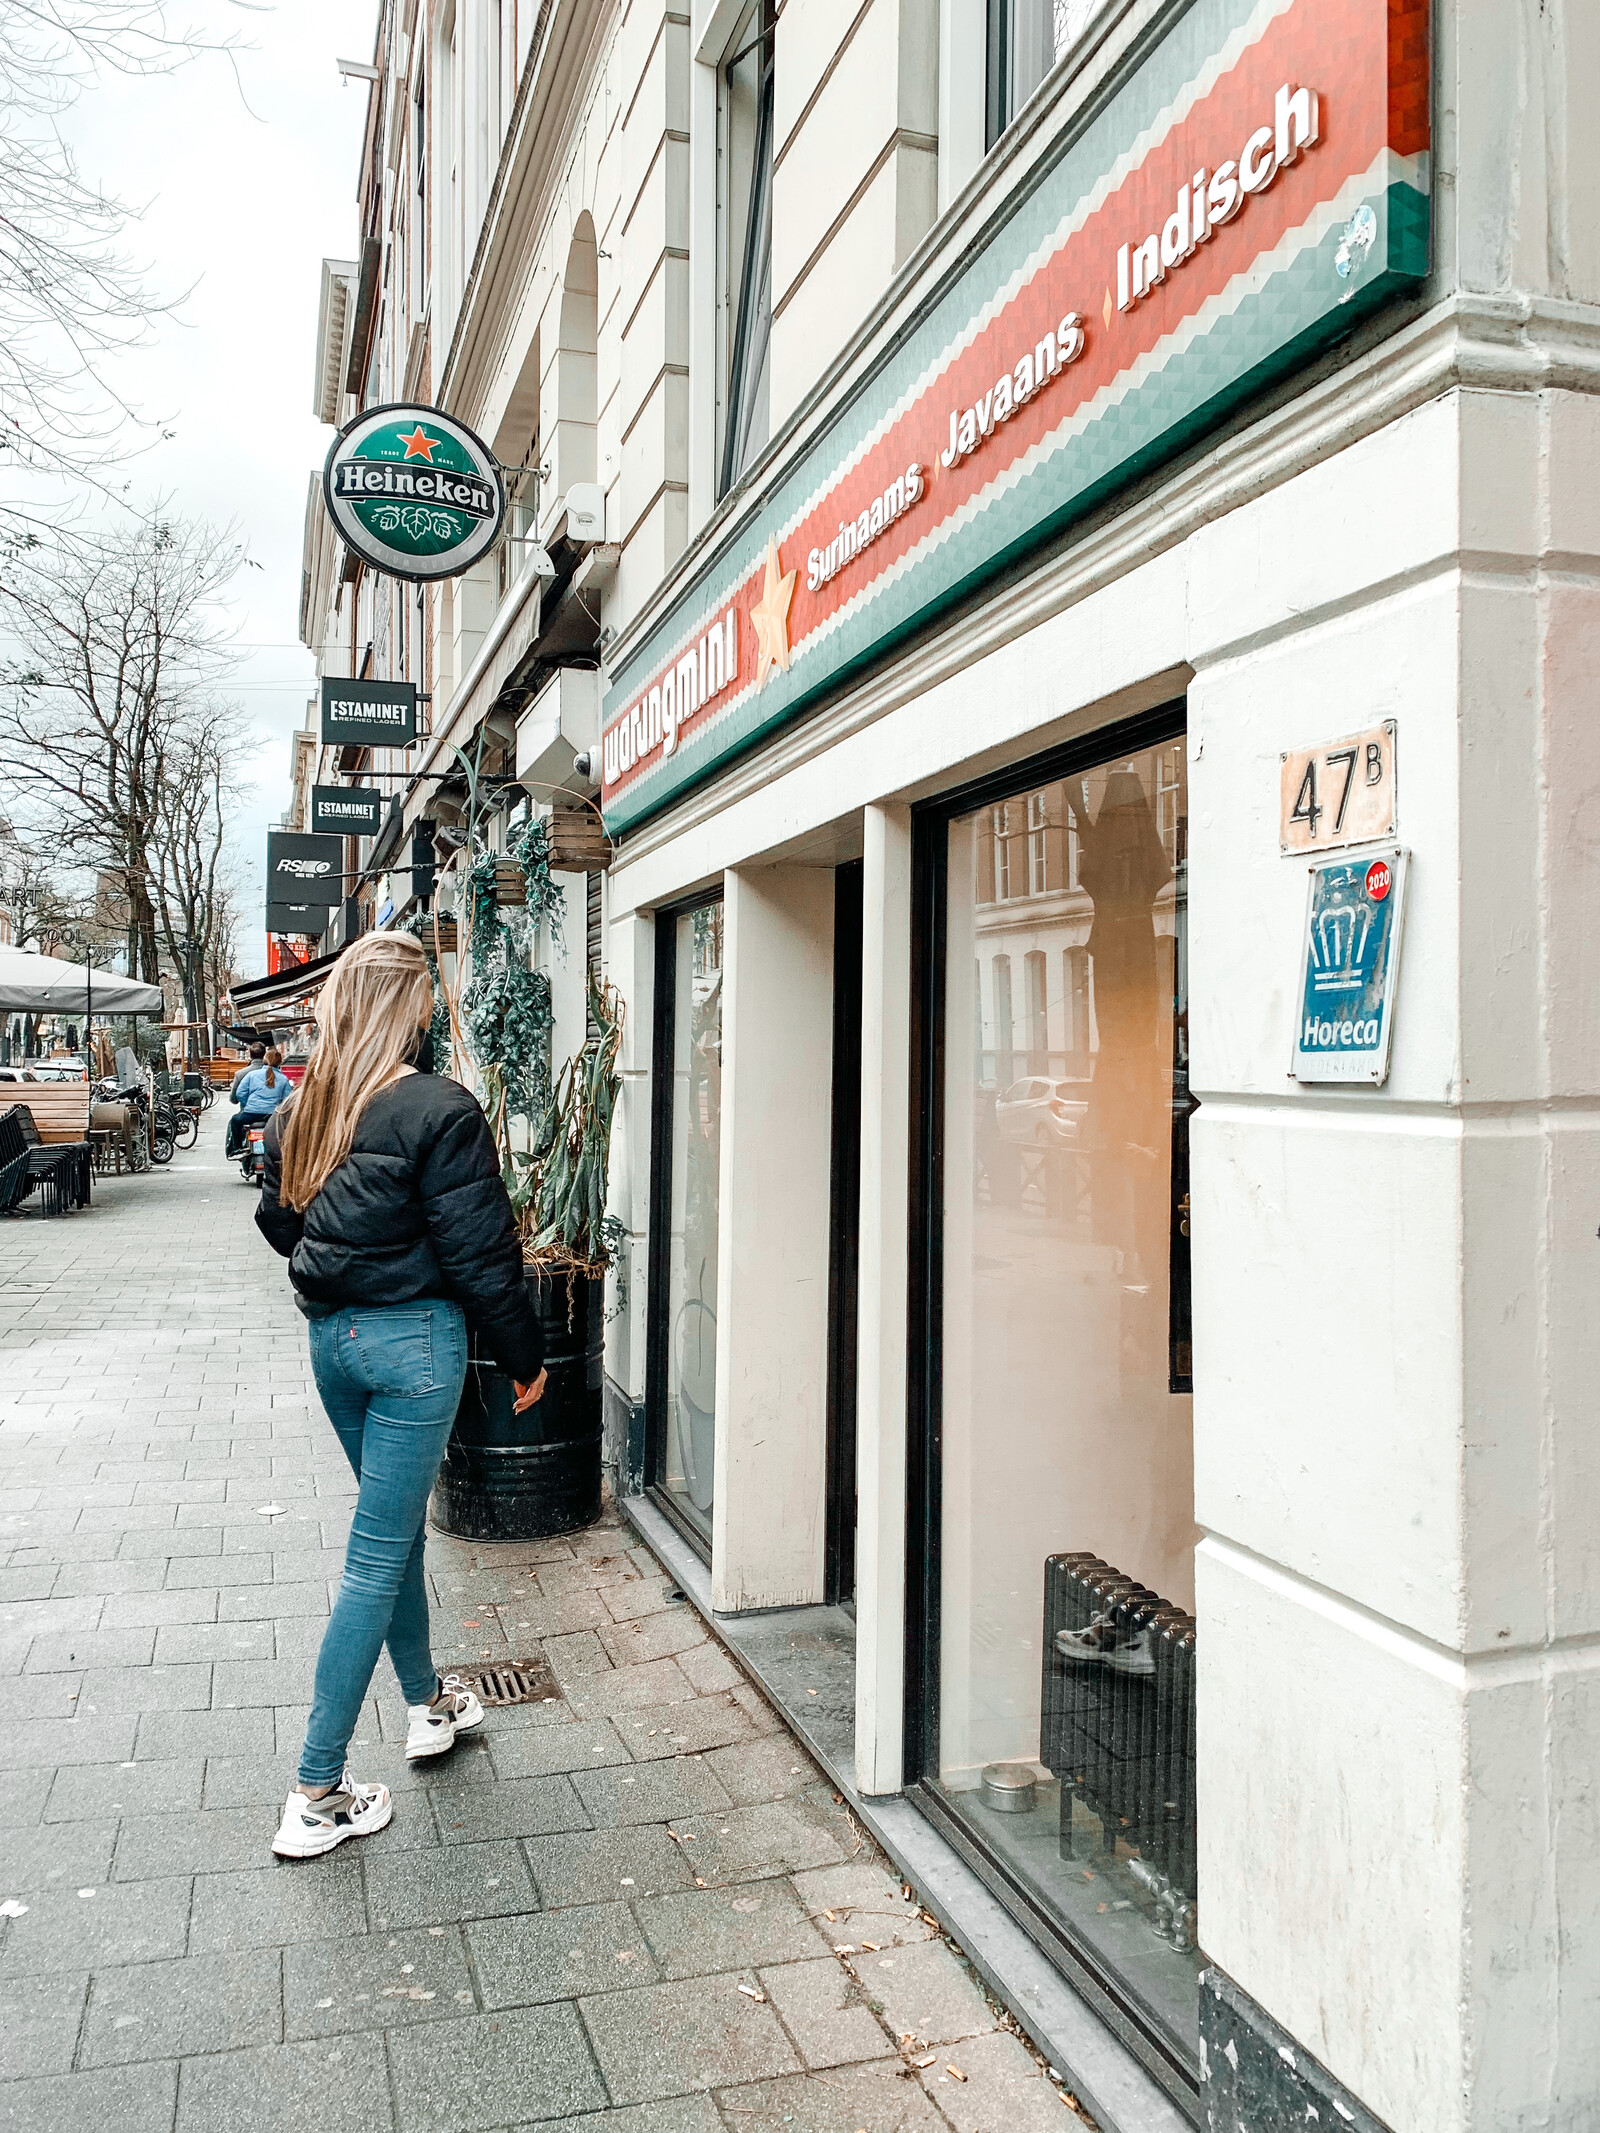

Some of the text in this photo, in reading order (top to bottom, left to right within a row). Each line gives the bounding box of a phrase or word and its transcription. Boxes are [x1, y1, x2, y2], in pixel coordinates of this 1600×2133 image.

[807, 462, 924, 591] Surinaams
[940, 311, 1085, 468] Javaans
[1117, 83, 1320, 312] Indisch
[342, 465, 489, 511] Heineken
[330, 700, 408, 726] ESTAMINET
[338, 716, 373, 724] REFINED
[318, 801, 375, 820] ESTAMINET
[1368, 869, 1390, 892] 2020
[33, 928, 87, 944] COOL
[1303, 1015, 1379, 1047] Horeca
